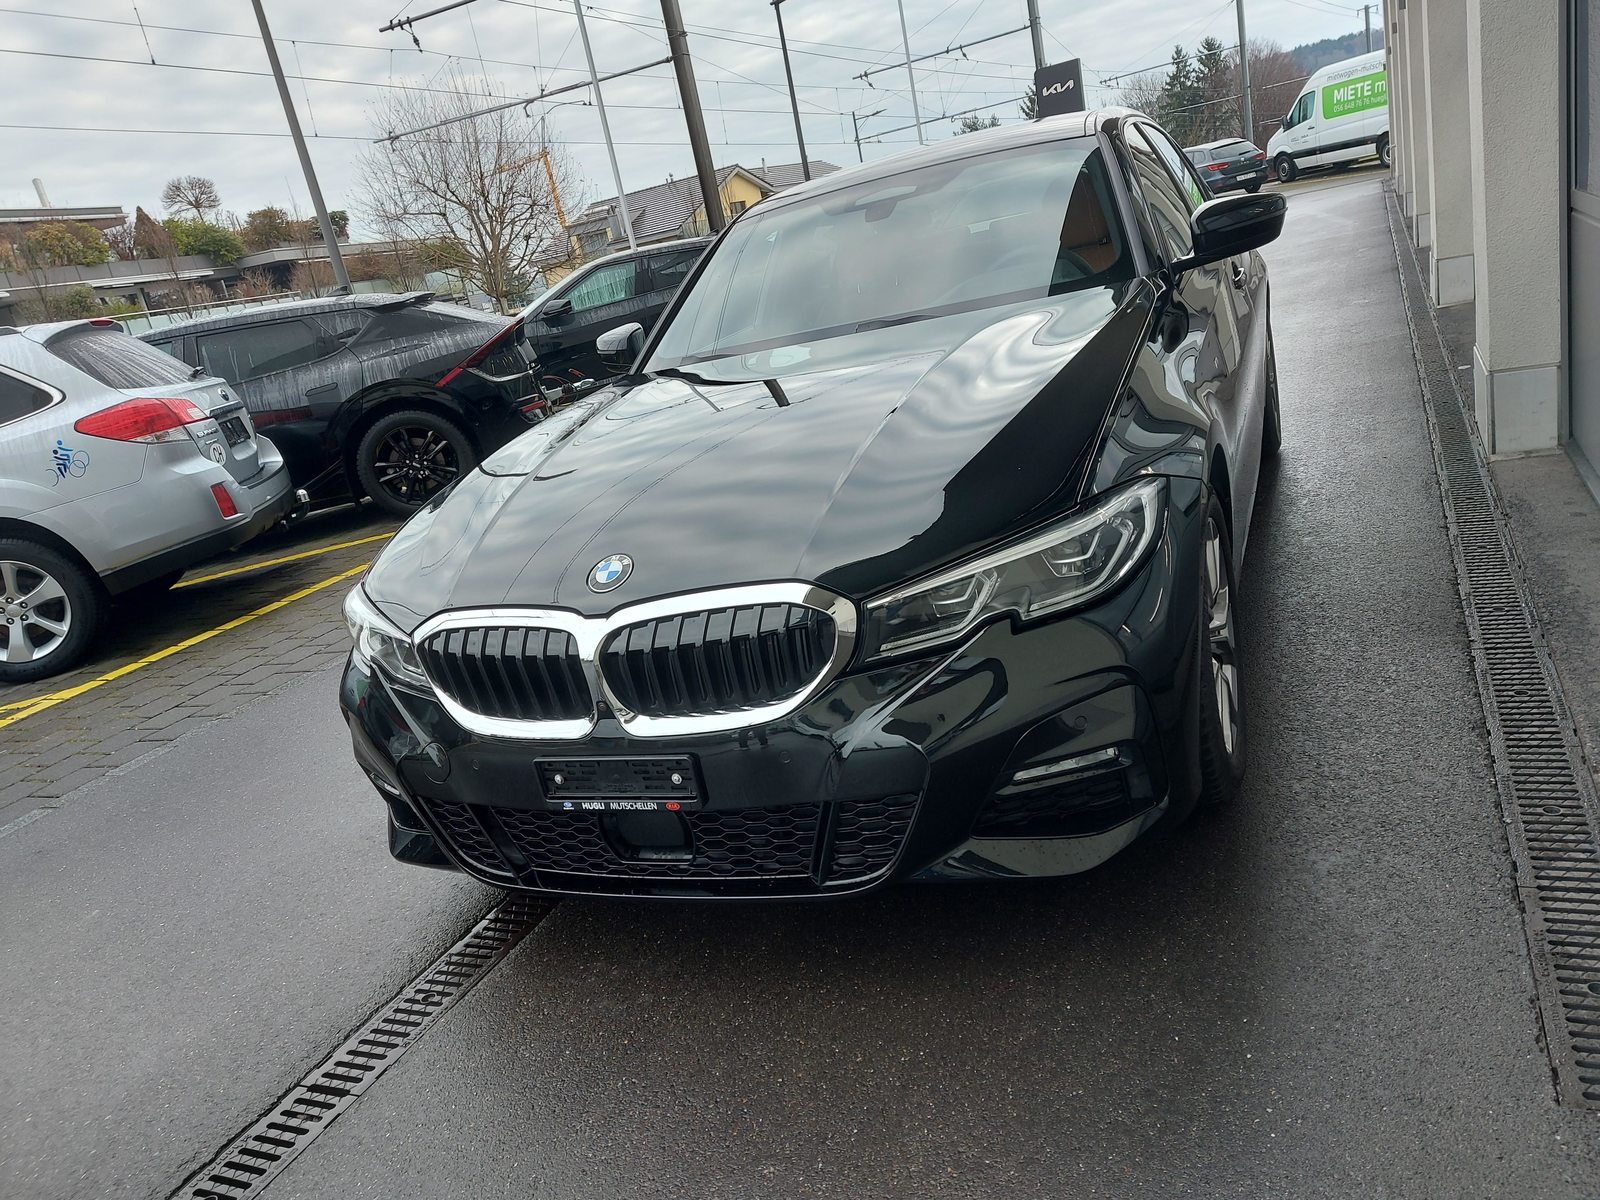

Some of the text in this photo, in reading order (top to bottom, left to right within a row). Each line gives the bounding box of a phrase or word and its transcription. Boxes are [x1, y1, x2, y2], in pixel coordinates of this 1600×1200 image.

[1042, 79, 1074, 97] KIA
[1333, 80, 1372, 104] MIETE
[1333, 103, 1344, 113] 056
[1355, 98, 1363, 107] 76
[1363, 96, 1370, 105] 76
[212, 445, 225, 463] CH
[610, 802, 657, 810] MUTSCHELLEN
